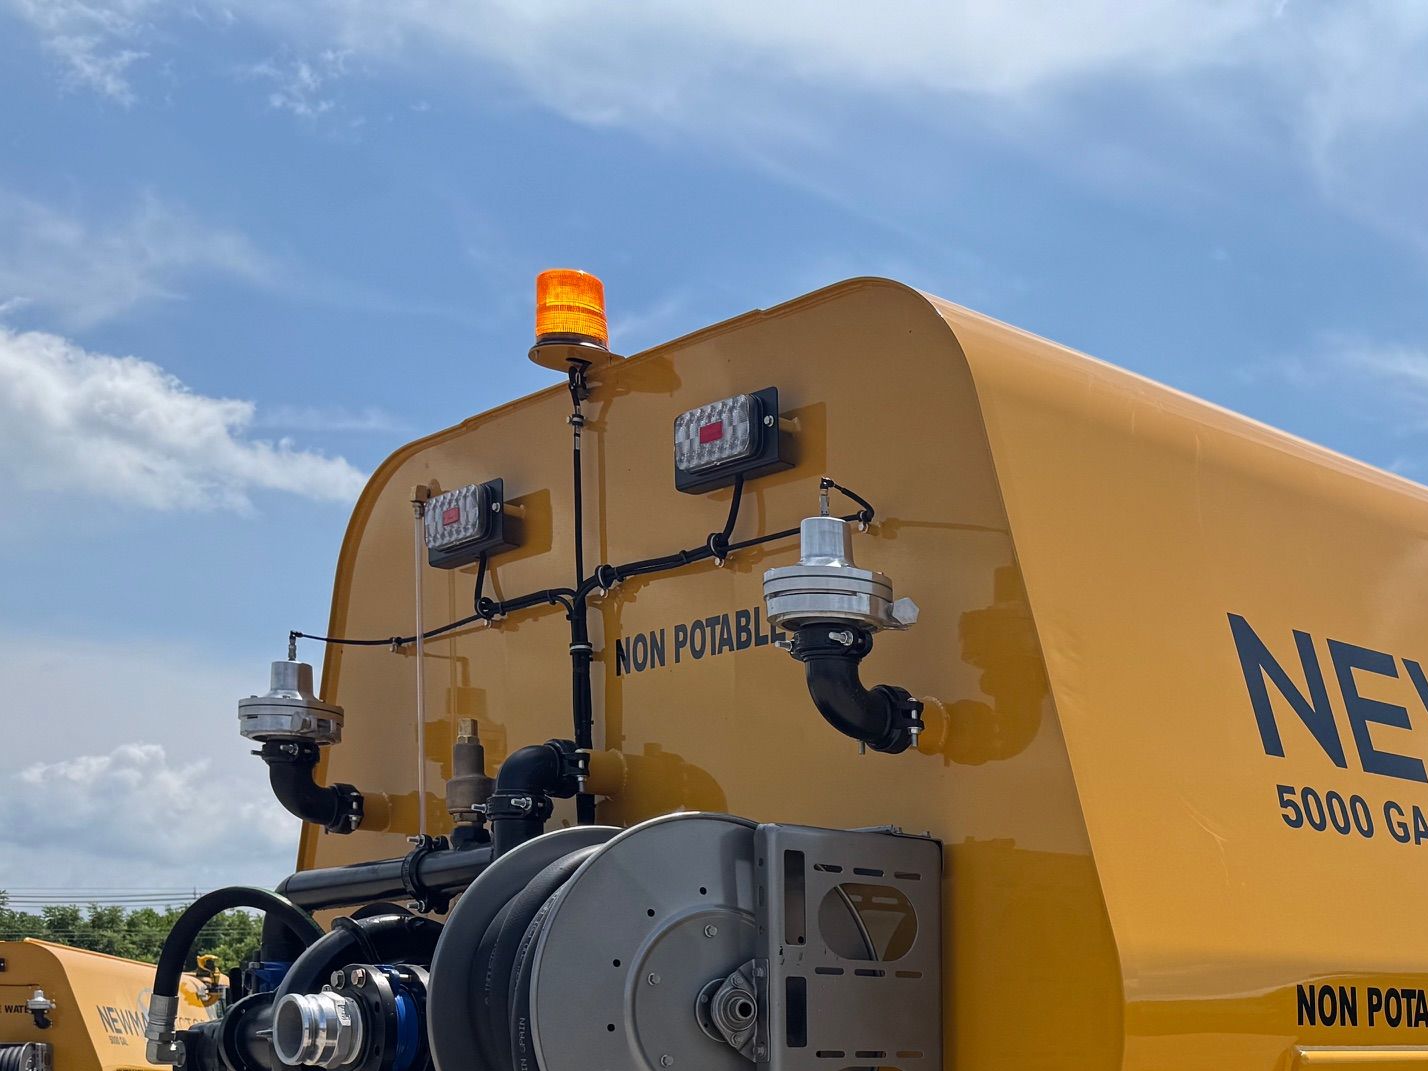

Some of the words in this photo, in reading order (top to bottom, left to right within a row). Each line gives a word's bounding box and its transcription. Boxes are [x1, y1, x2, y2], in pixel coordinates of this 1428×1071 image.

[616, 628, 666, 676] NON
[1276, 784, 1374, 839] 5000
[1296, 984, 1358, 1027] NON
[520, 1058, 528, 1071] IN
